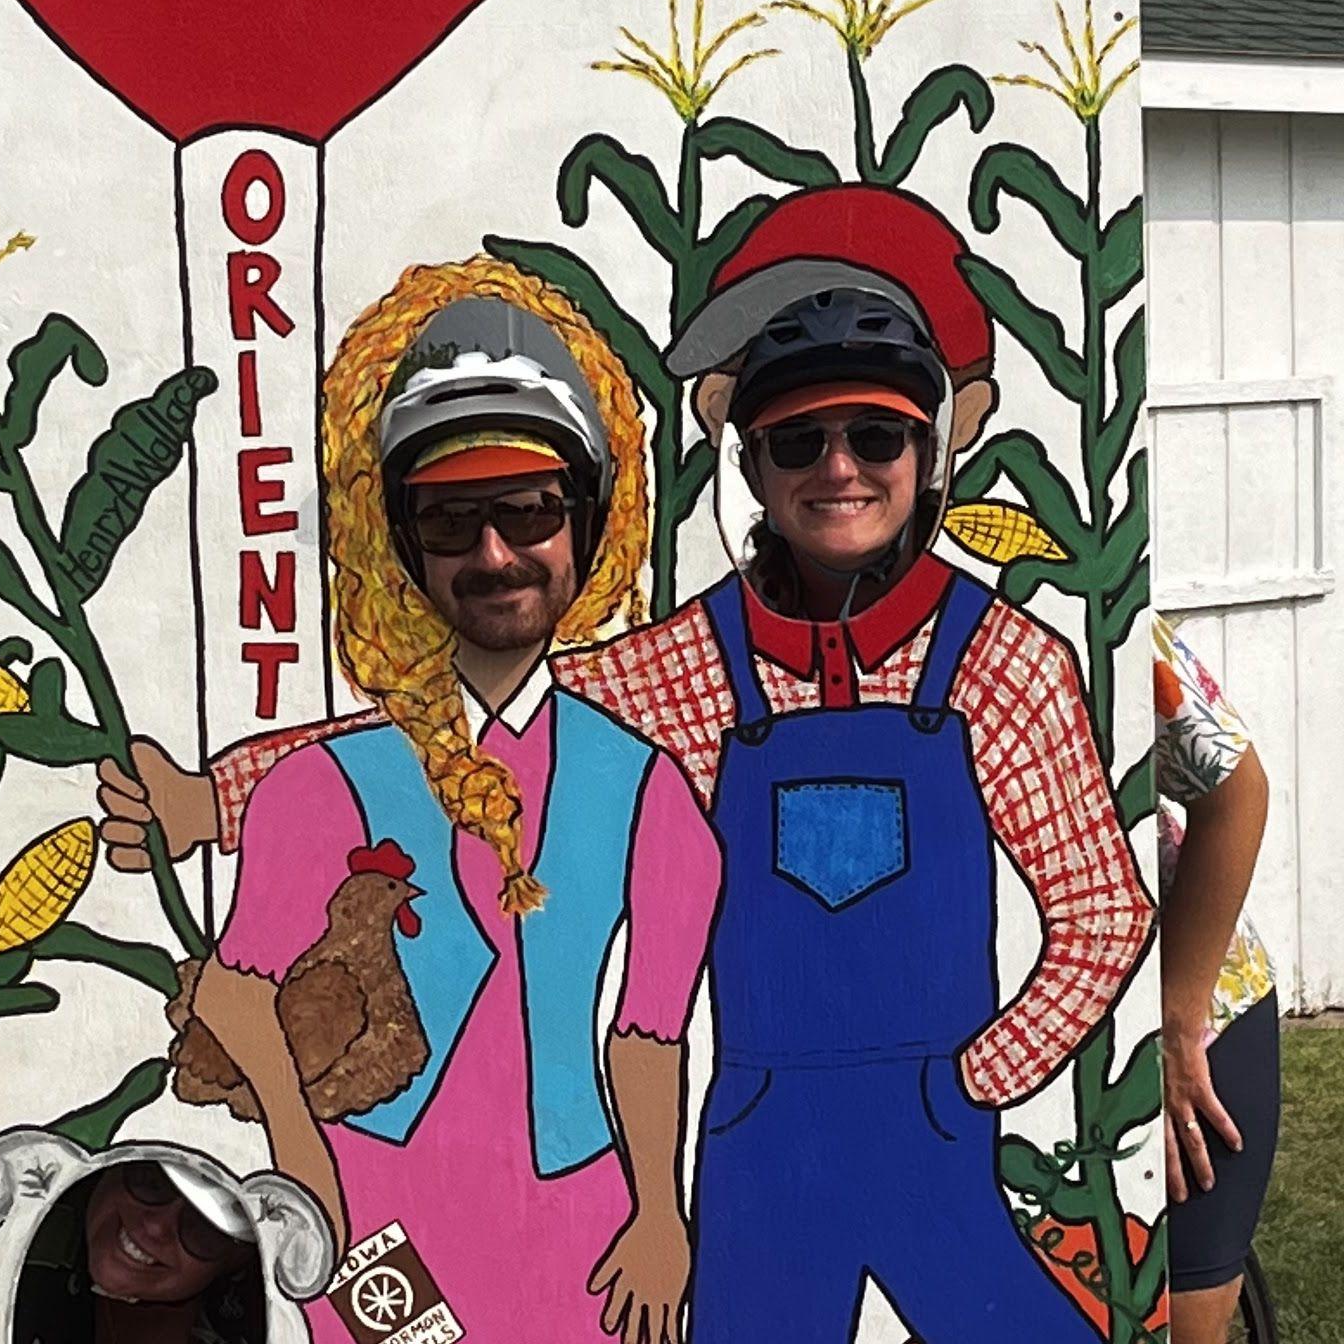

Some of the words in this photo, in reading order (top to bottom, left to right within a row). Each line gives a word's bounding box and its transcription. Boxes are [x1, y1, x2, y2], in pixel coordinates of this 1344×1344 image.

[108, 373, 208, 492] Wallace
[221, 149, 298, 720] ORIENT
[100, 470, 139, 513] A
[56, 496, 128, 594] Henry
[335, 1232, 397, 1284] IOWA
